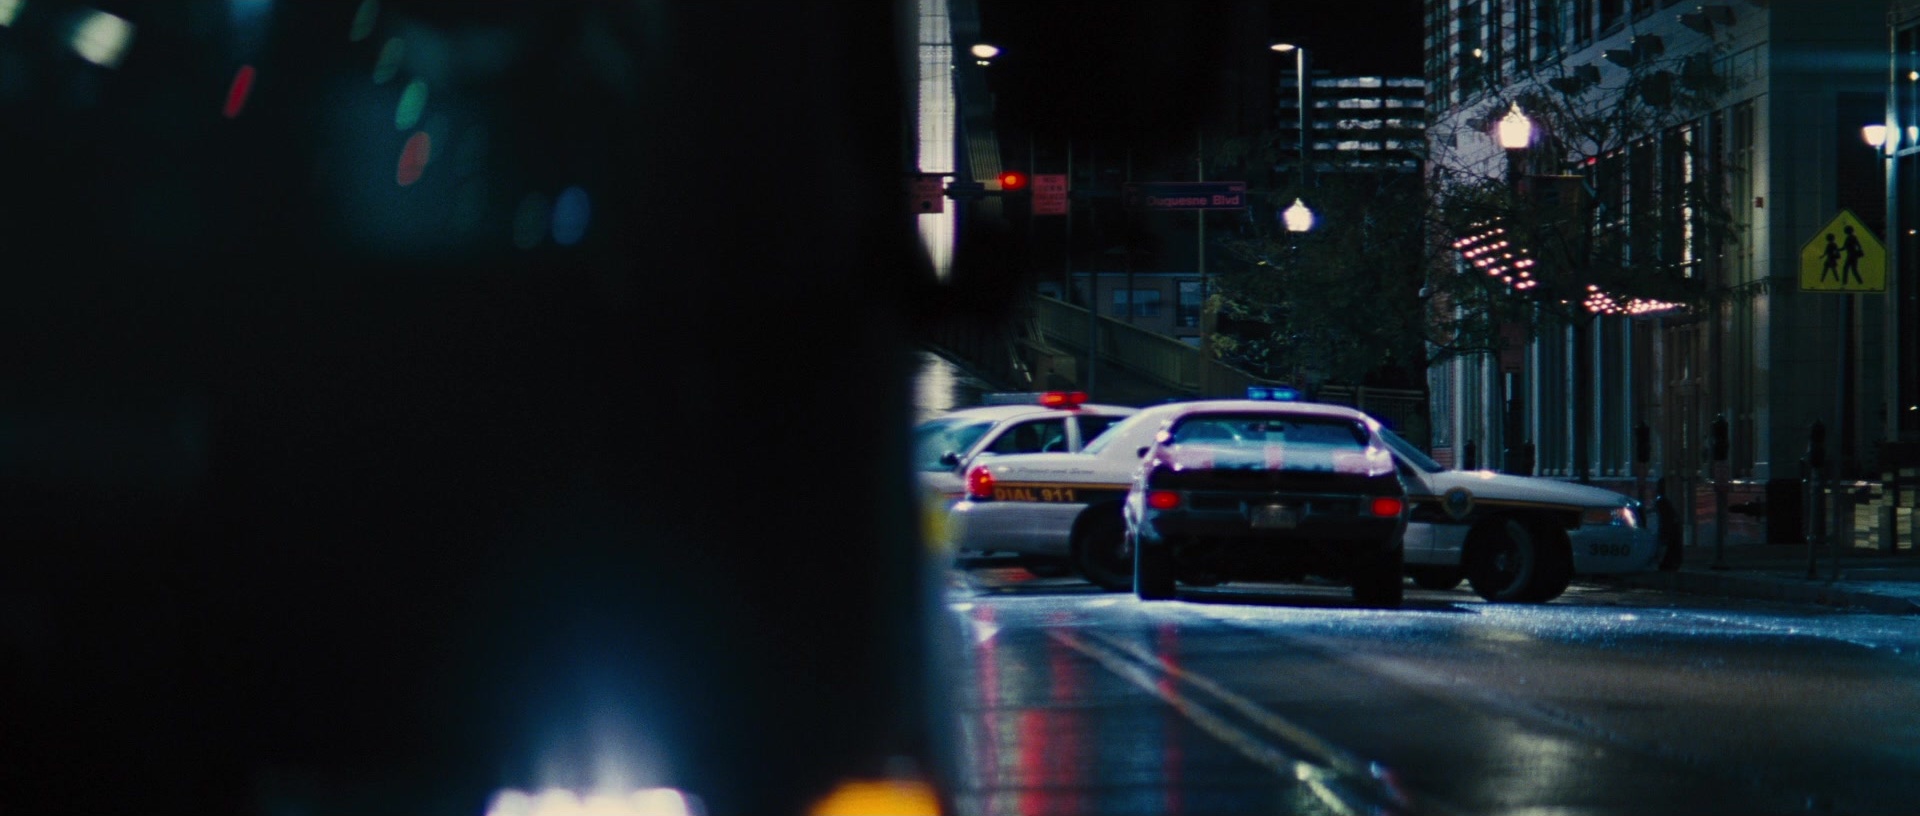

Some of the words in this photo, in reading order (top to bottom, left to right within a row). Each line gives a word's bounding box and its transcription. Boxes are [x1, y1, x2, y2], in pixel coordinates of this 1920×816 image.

[1147, 195, 1207, 207] Duquesne
[1213, 195, 1240, 205] Blvd
[995, 488, 1037, 501] DIAL
[1041, 488, 1075, 501] 911
[1588, 543, 1631, 557] 3980
